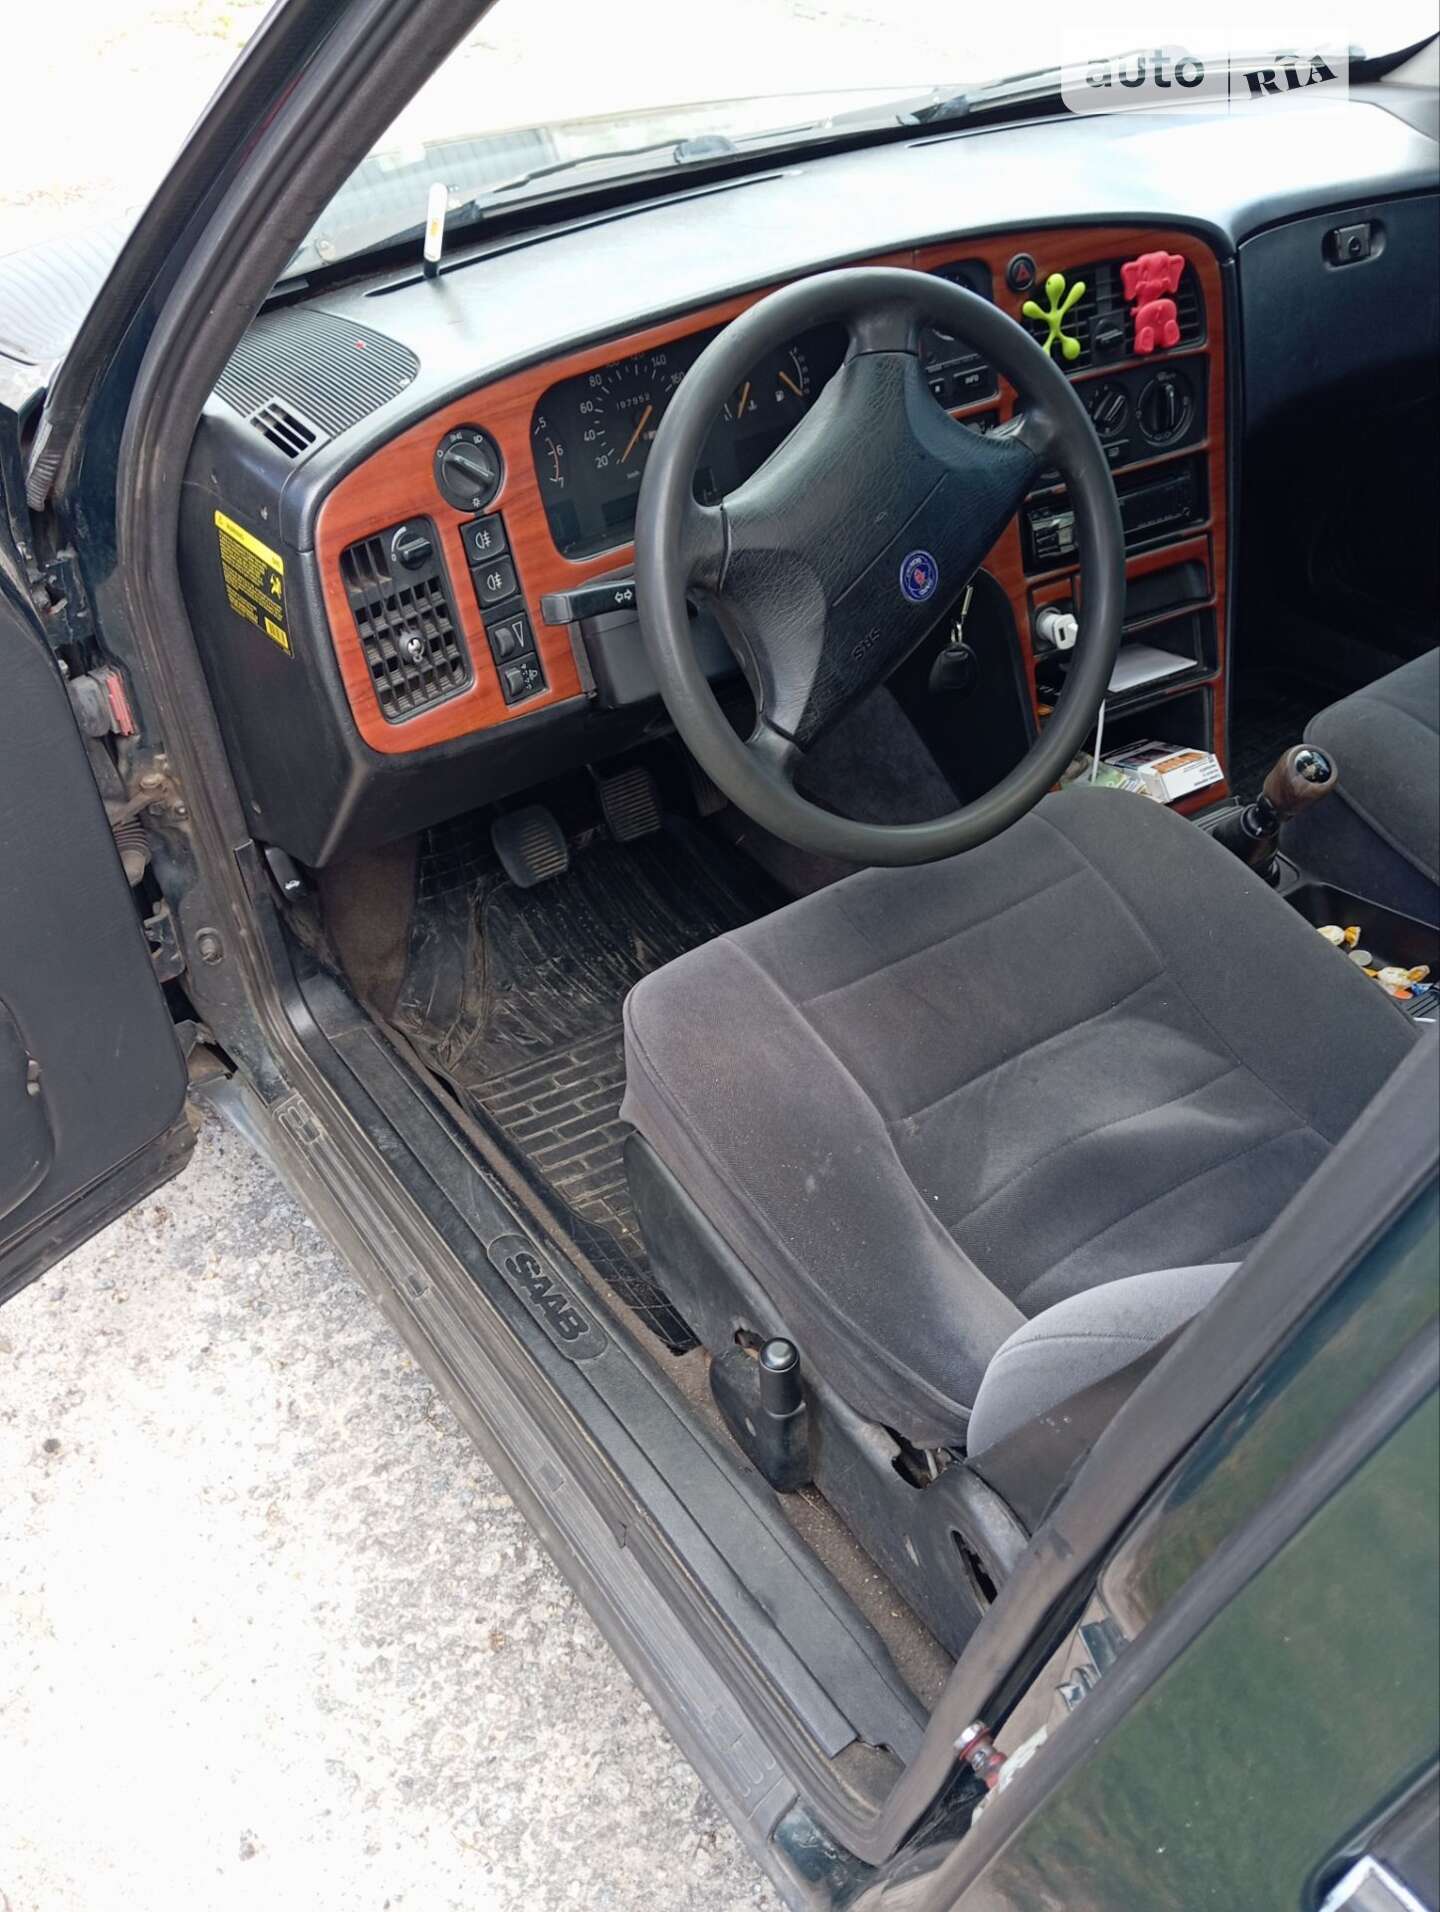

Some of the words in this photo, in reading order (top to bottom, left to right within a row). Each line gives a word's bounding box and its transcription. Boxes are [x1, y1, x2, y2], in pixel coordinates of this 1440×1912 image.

[651, 355, 666, 367] 140
[588, 374, 602, 387] 80
[579, 400, 594, 414] 60
[538, 415, 547, 428] 5
[583, 428, 597, 442] 40
[555, 443, 564, 456] 6
[596, 456, 608, 469] 20
[558, 476, 565, 489] 7
[504, 1251, 590, 1342] SAAB
